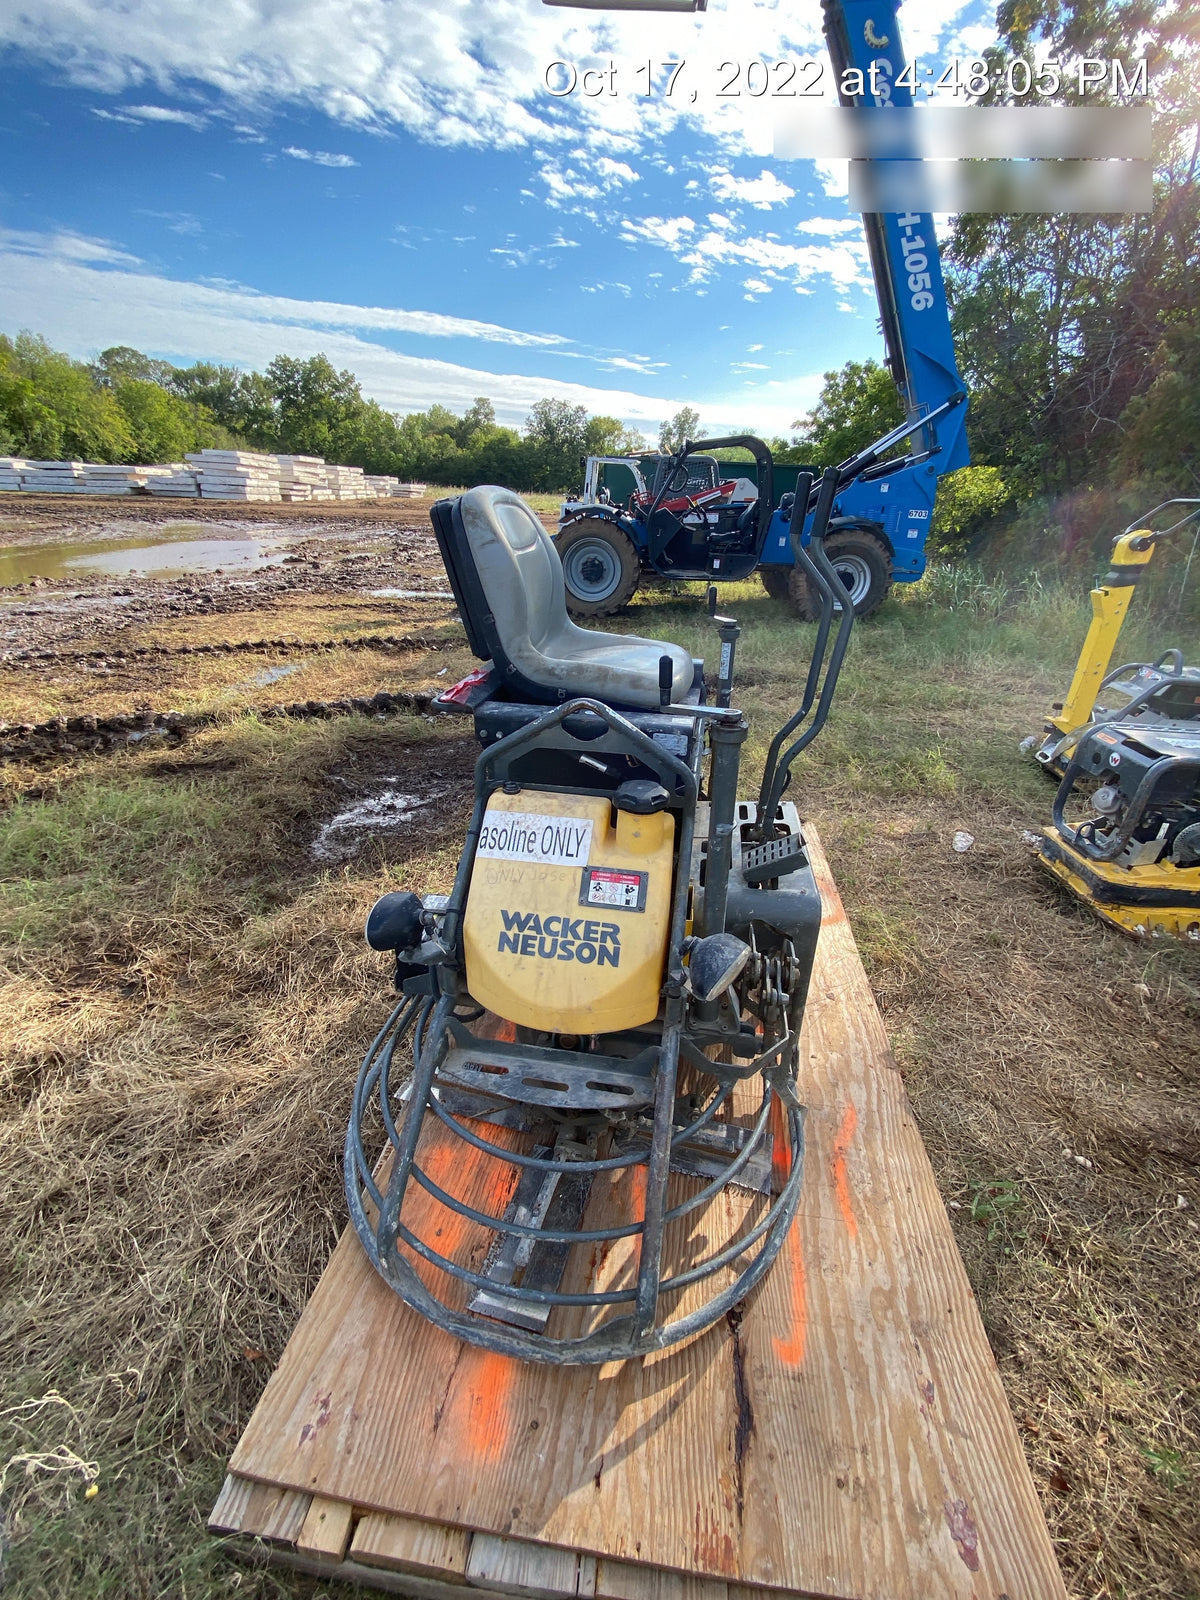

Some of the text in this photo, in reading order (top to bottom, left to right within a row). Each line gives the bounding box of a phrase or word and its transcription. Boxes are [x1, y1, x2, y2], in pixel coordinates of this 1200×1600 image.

[909, 510, 928, 518] 6703
[541, 825, 587, 858] ONLY
[500, 909, 622, 946] WACKER
[498, 931, 621, 968] NEUSON
